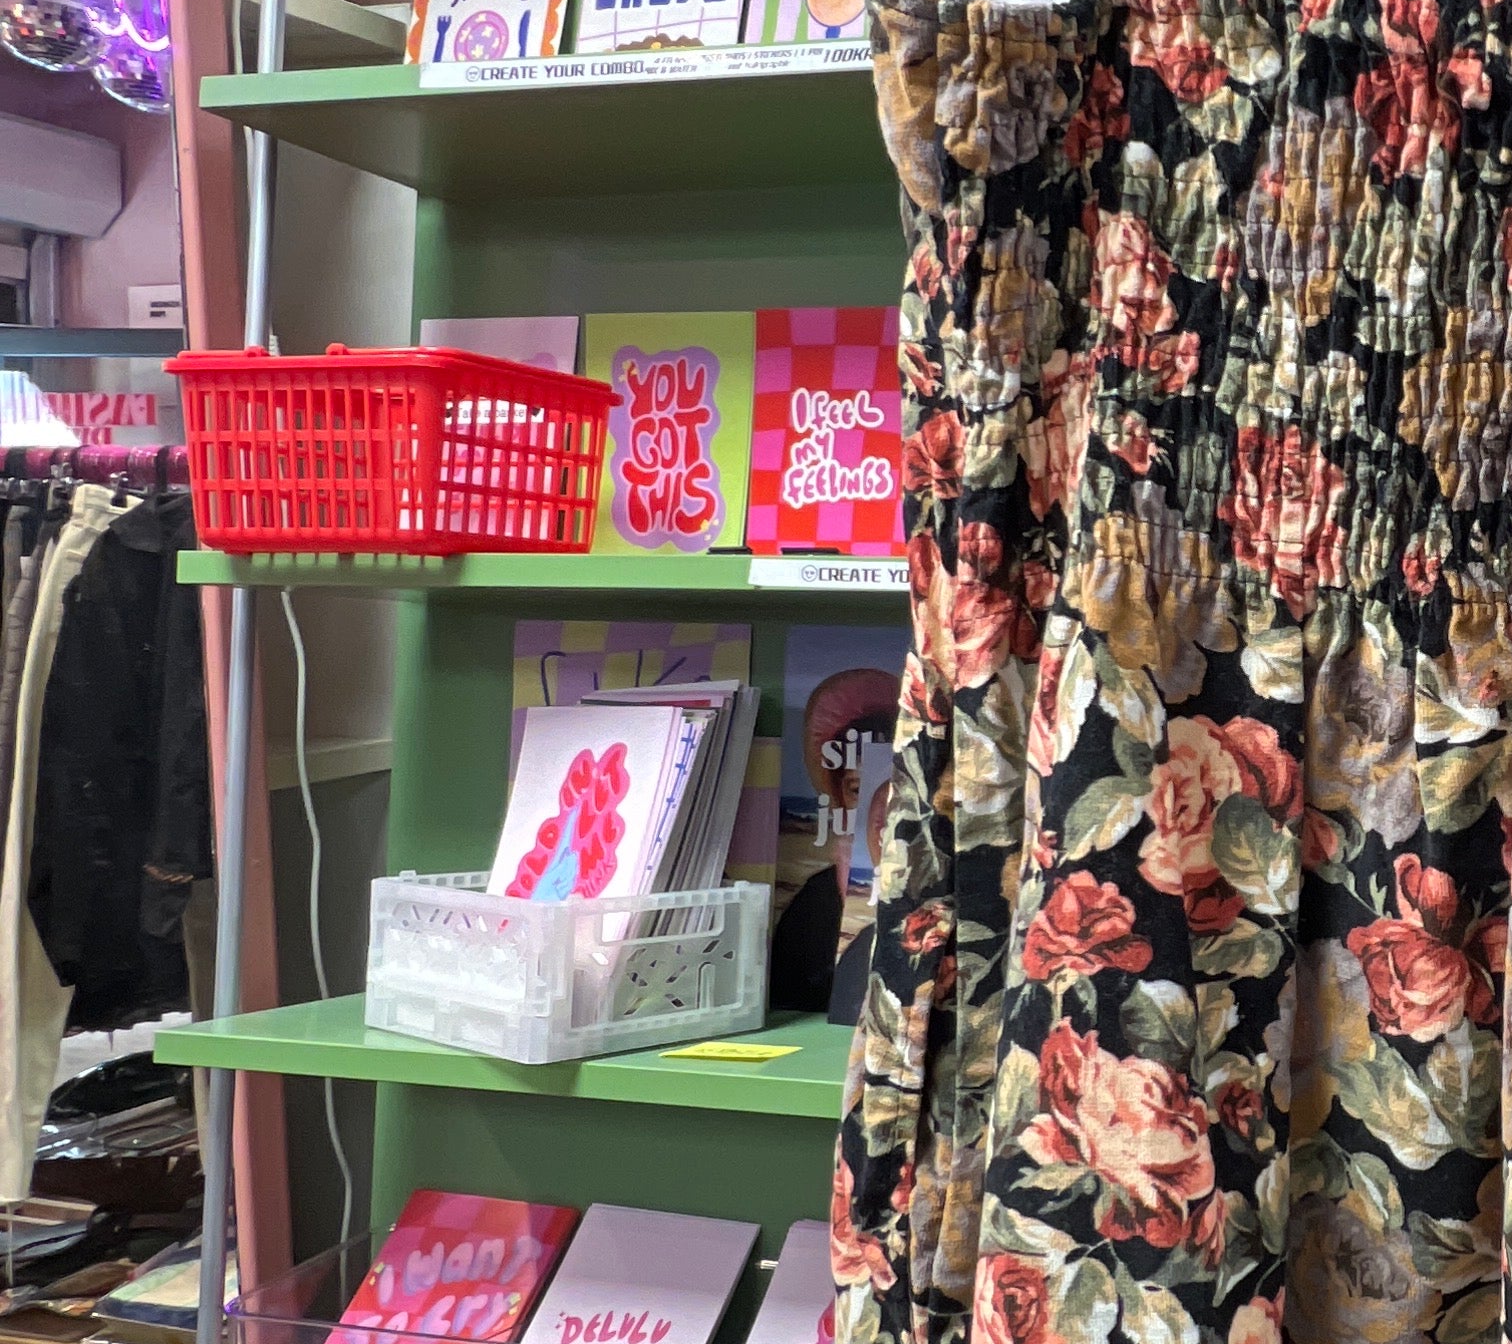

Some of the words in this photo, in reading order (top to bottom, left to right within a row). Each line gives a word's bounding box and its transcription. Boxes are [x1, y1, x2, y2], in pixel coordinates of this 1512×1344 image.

[481, 65, 538, 81] CREATE
[543, 63, 585, 78] YOUR
[591, 60, 645, 77] COMBO
[626, 357, 706, 420] YOU
[631, 407, 712, 470] GOT
[620, 461, 717, 535] THIS
[818, 567, 881, 583] CREATE
